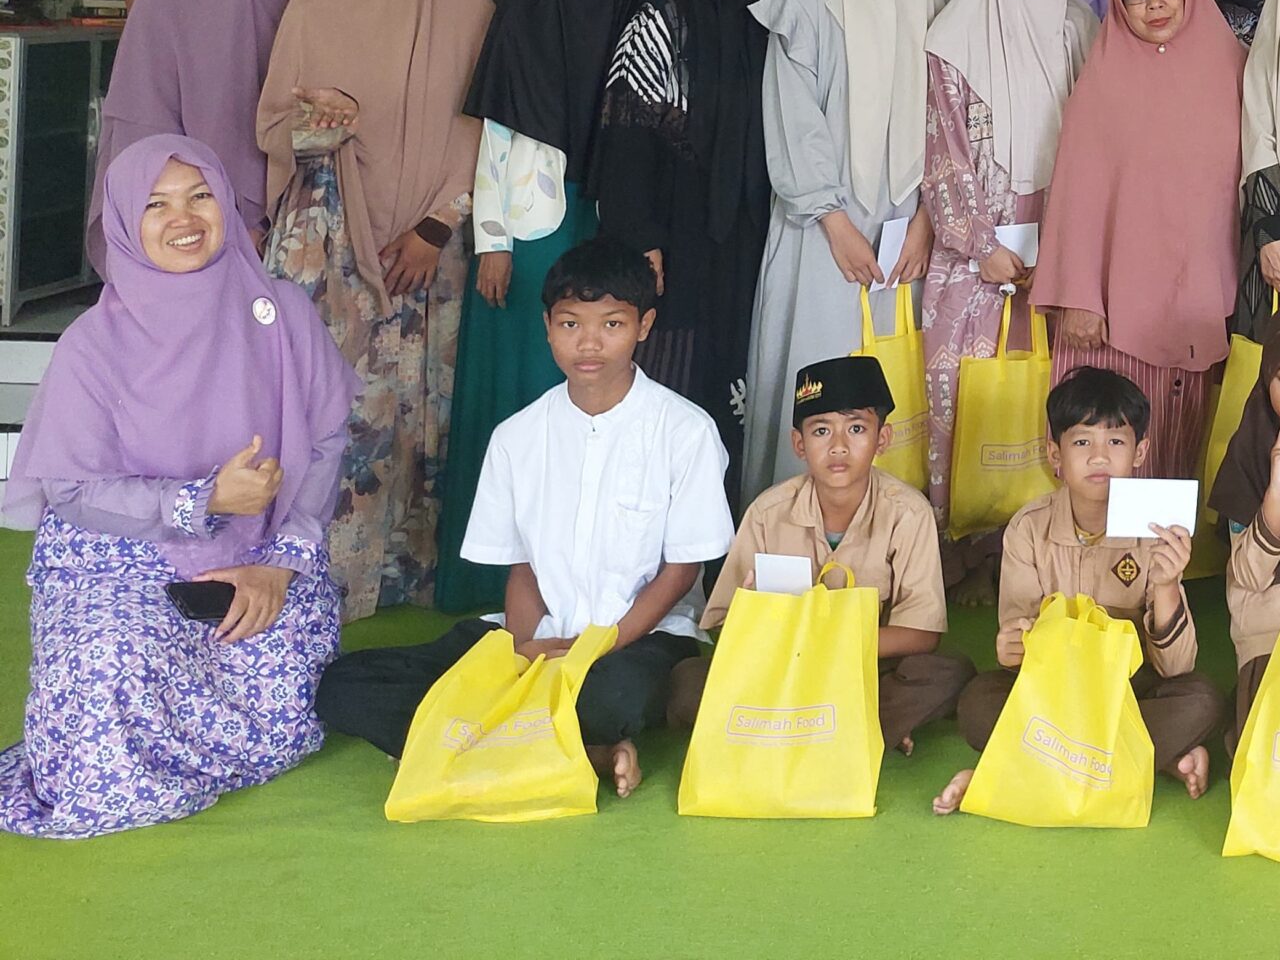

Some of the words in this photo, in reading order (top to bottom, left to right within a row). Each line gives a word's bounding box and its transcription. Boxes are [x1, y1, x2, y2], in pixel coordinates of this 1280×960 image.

[735, 714, 793, 732] Salimah
[796, 713, 826, 730] Food
[1034, 728, 1089, 767] Salimah
